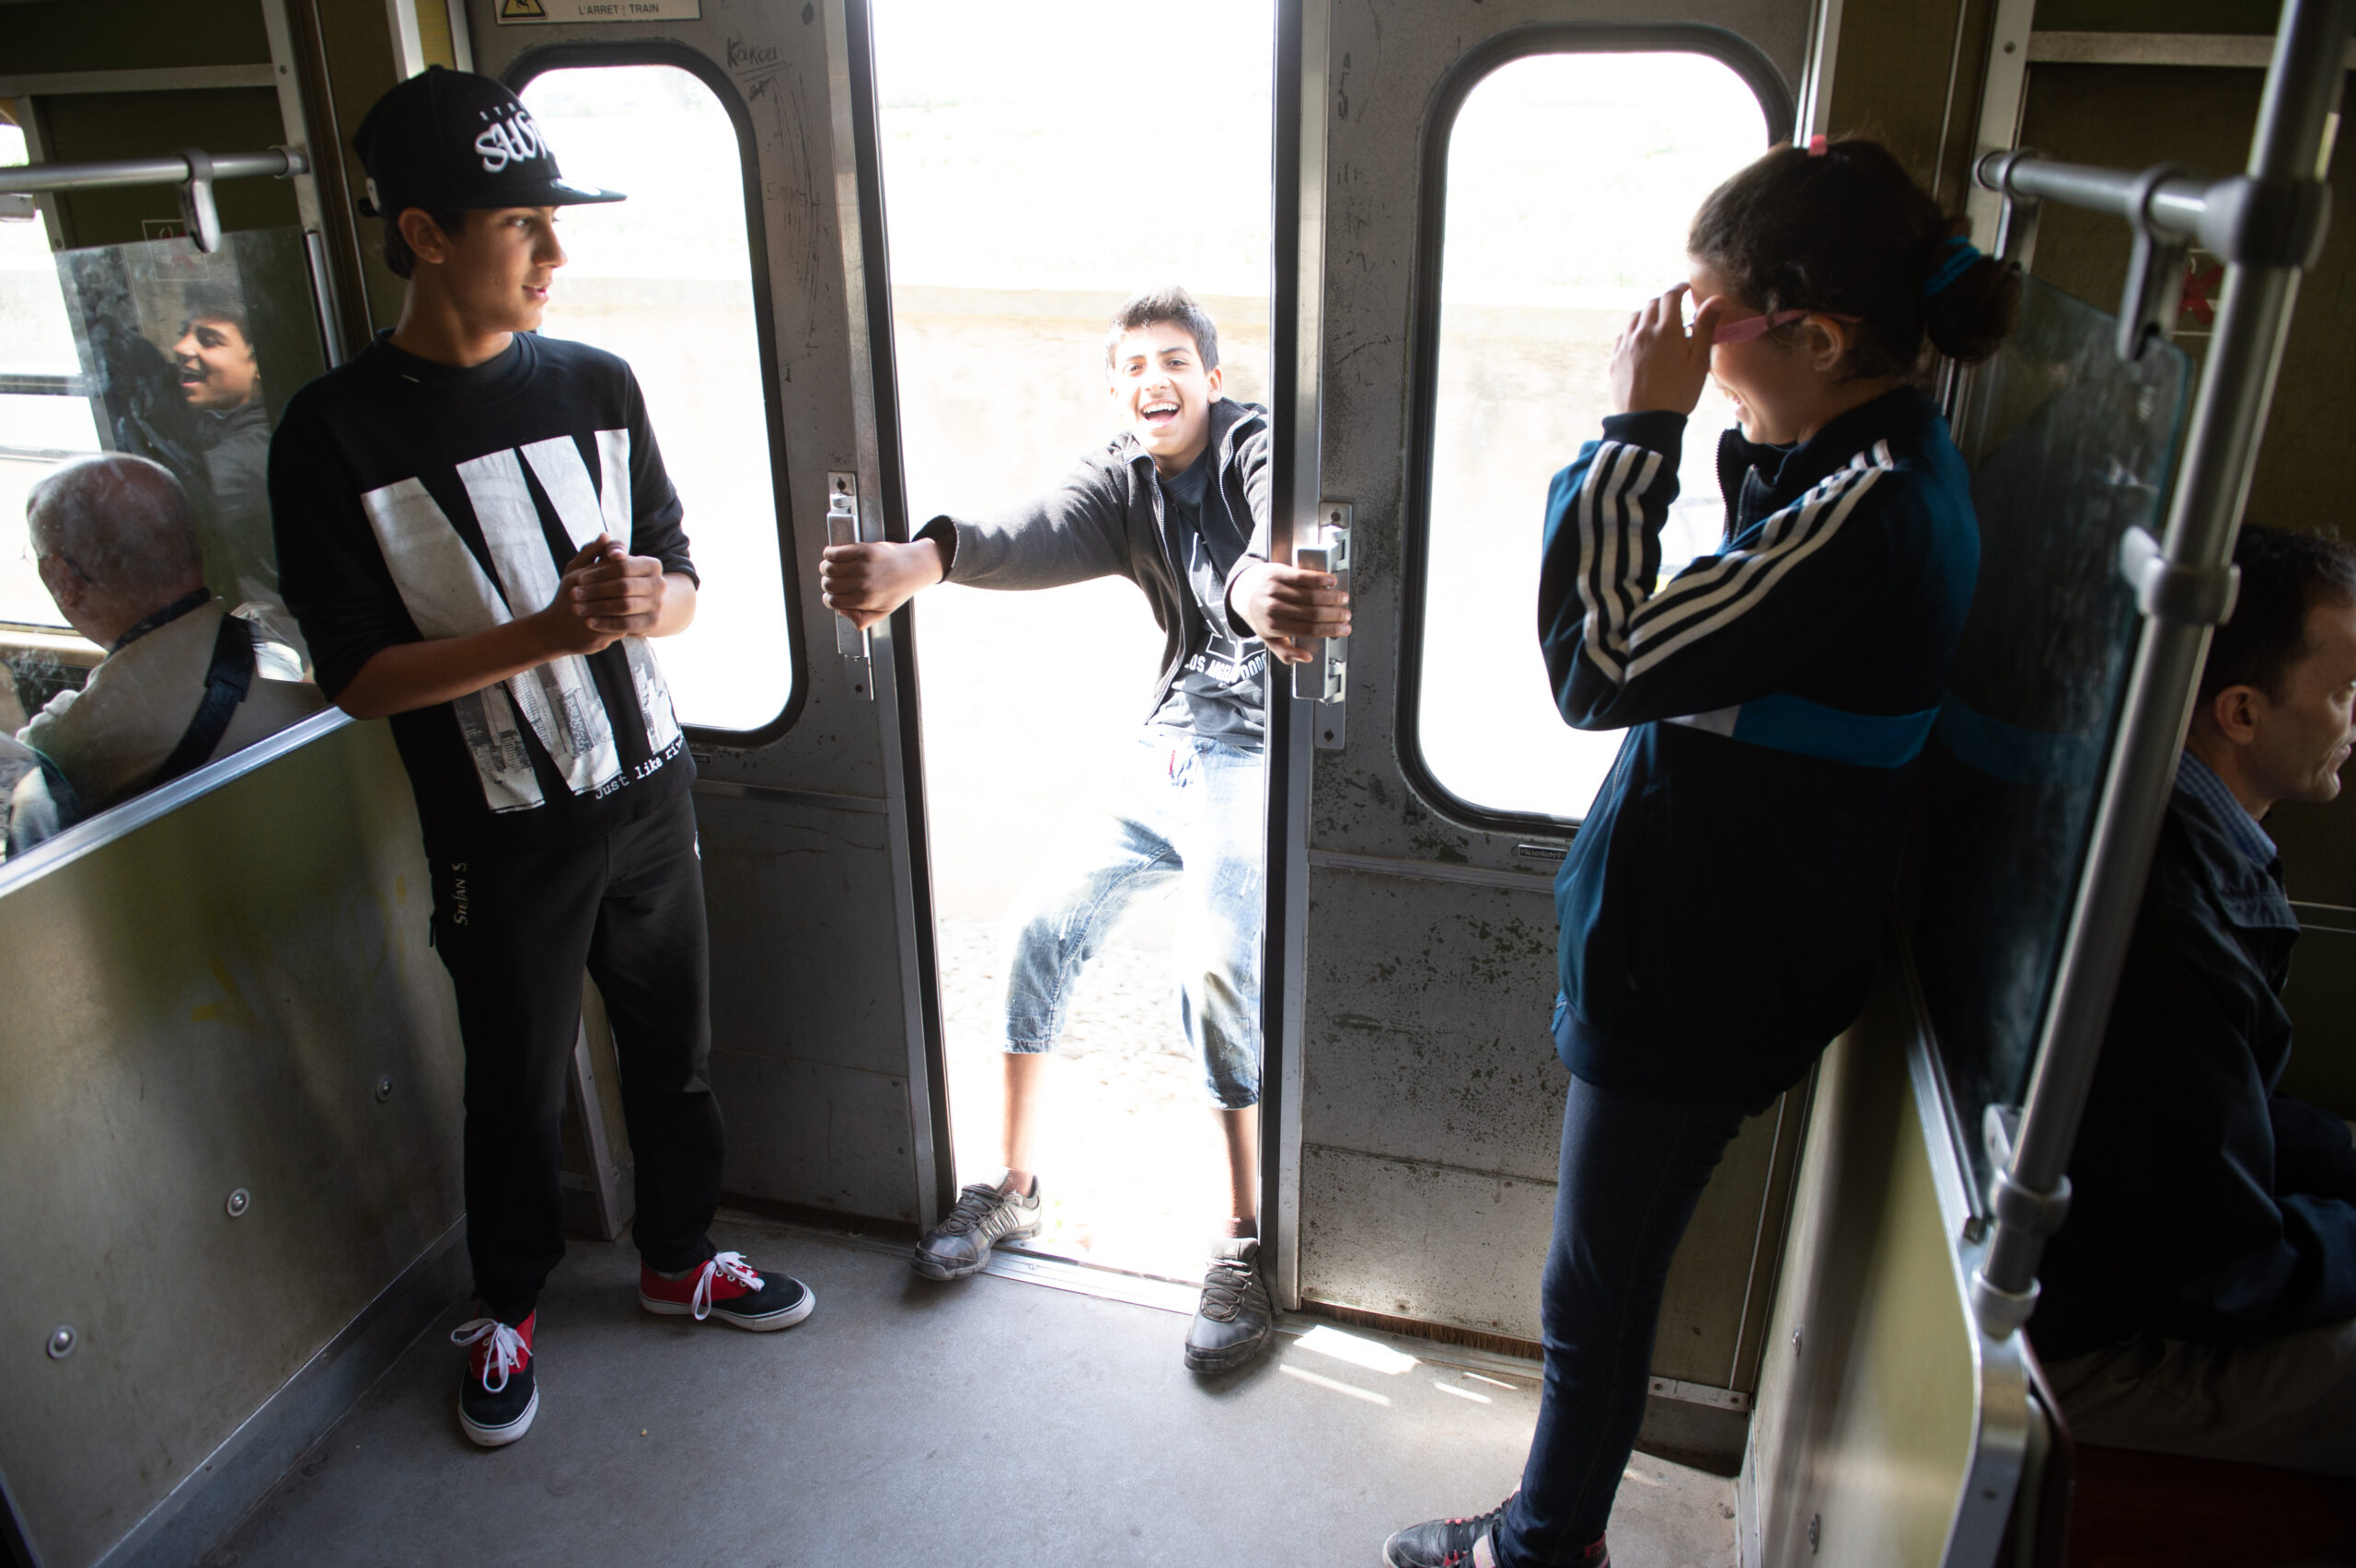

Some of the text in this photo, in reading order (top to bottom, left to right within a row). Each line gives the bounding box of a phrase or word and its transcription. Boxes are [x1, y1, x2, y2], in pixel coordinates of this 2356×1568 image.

[578, 4, 618, 16] L'ARRET
[629, 3, 660, 14] TRAIN
[1184, 653, 1206, 673] OS
[634, 756, 663, 779] like
